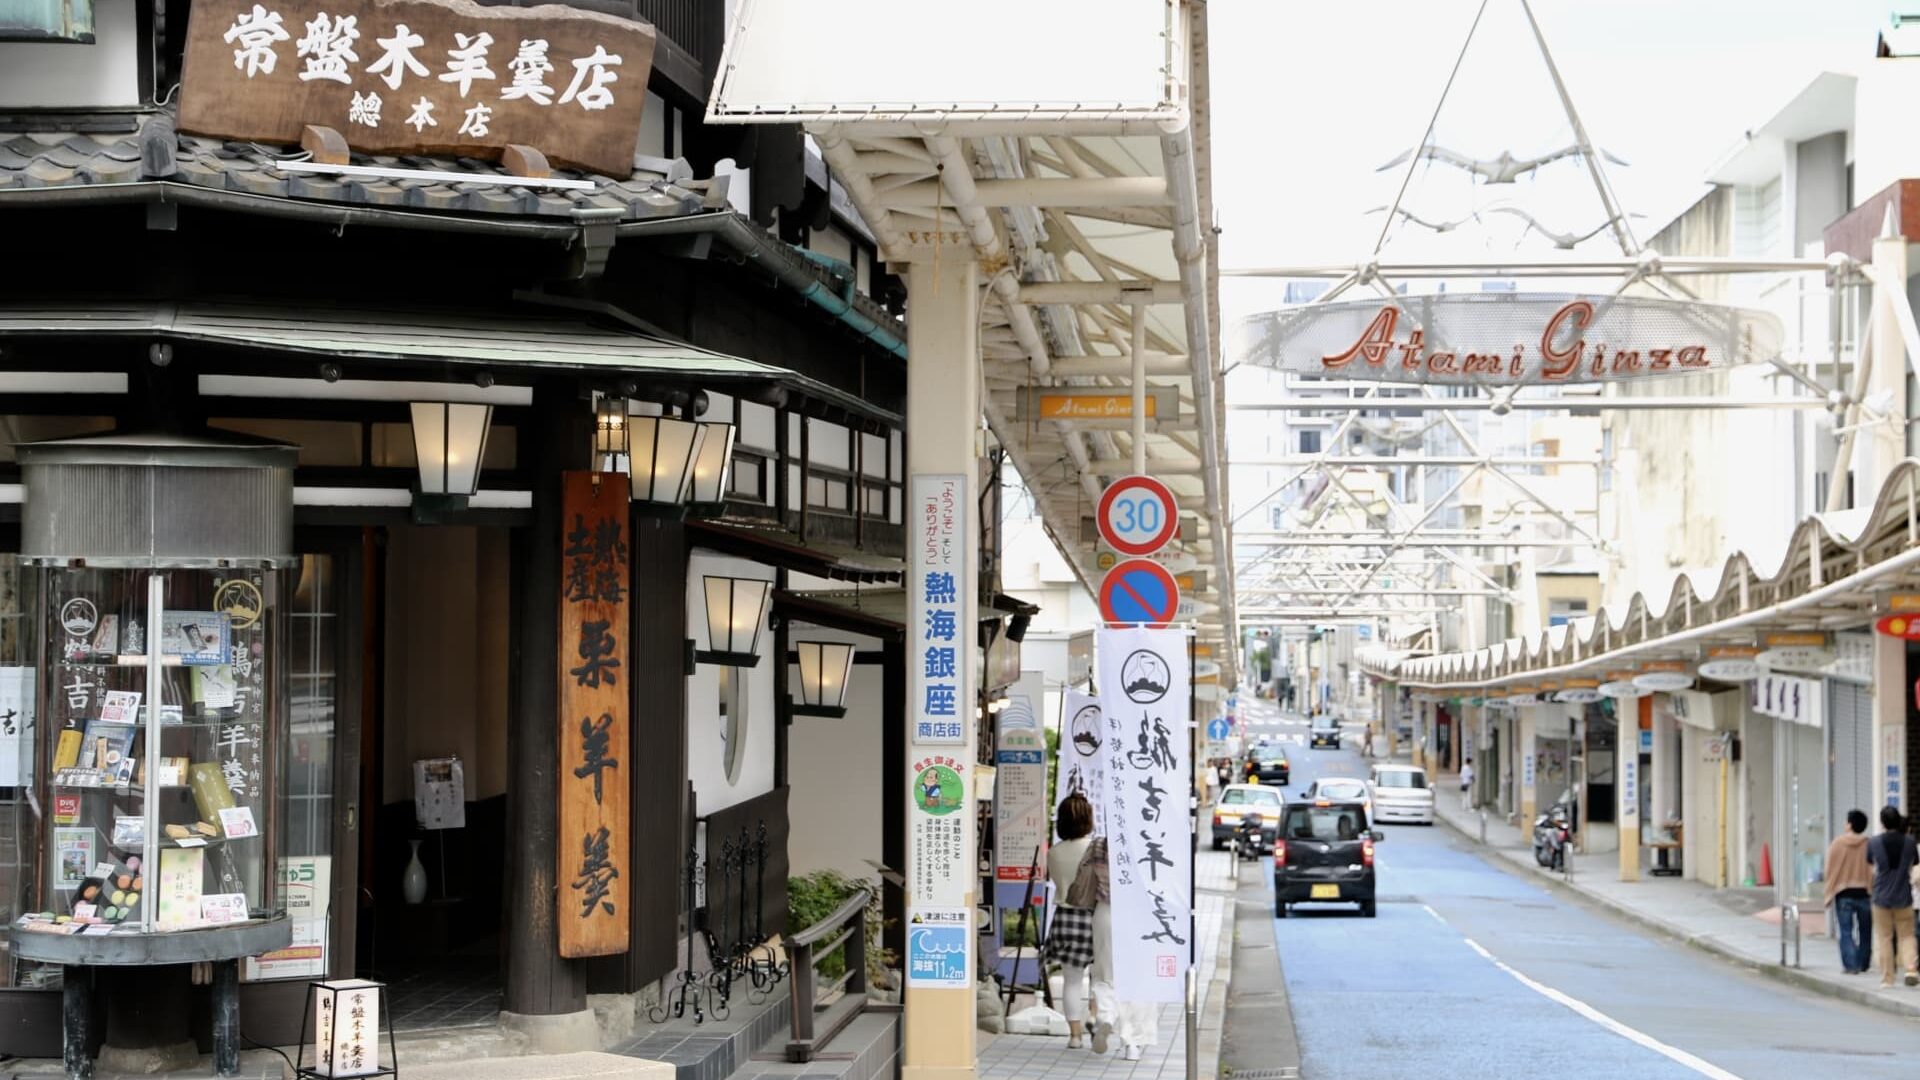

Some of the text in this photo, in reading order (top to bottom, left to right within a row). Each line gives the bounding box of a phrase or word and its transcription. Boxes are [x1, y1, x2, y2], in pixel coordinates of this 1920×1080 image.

[224, 4, 623, 111] 常盤木羊羹店
[1322, 300, 1710, 379] Atami Ginza
[1116, 499, 1158, 533] 30
[925, 572, 956, 716] 熱海銀座
[918, 722, 961, 738] 商店街
